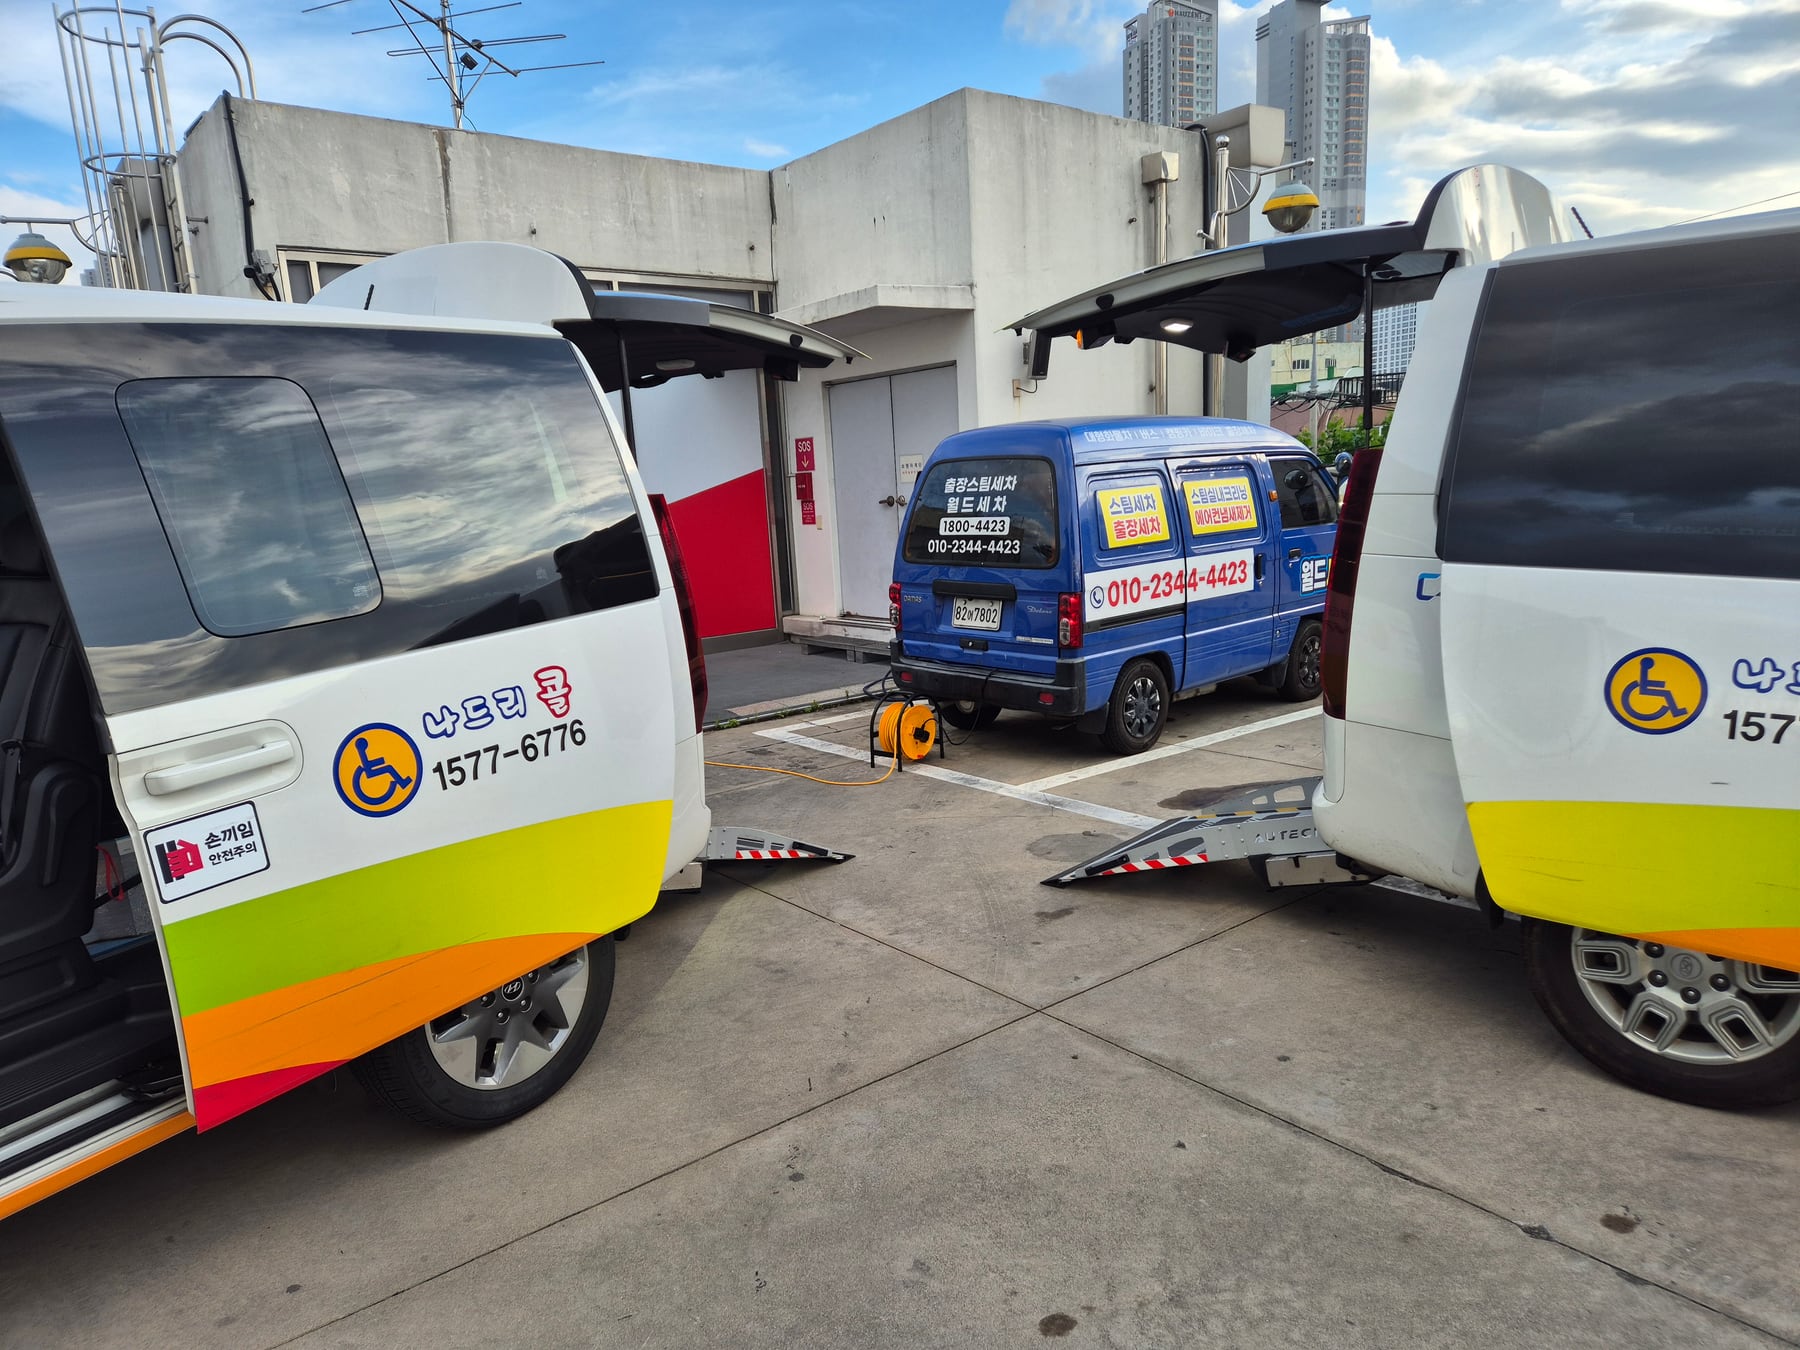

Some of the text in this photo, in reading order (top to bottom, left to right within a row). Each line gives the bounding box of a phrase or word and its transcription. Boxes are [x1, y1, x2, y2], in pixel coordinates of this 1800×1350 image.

[1139, 428, 1160, 440] 버스
[797, 441, 812, 453] SOS
[944, 475, 1018, 494] 출장스팀세차
[1191, 484, 1248, 505] 스팀실내크리닝
[802, 502, 814, 511] SOS
[1109, 493, 1157, 516] 스팀세차
[1195, 505, 1252, 527] 에어컨냄새제거
[943, 520, 1006, 533] 1800-4423
[1113, 516, 1161, 540] 출장세차
[927, 539, 1020, 554] 010-2344-4423
[1107, 559, 1248, 607] 010-2344-4423
[1301, 559, 1326, 593] 월드
[422, 665, 572, 739] 나드리 콜
[1723, 709, 1800, 744] 157
[432, 719, 587, 791] 1577-6776
[204, 821, 254, 849] 손끼임
[208, 841, 257, 866] 안전주의
